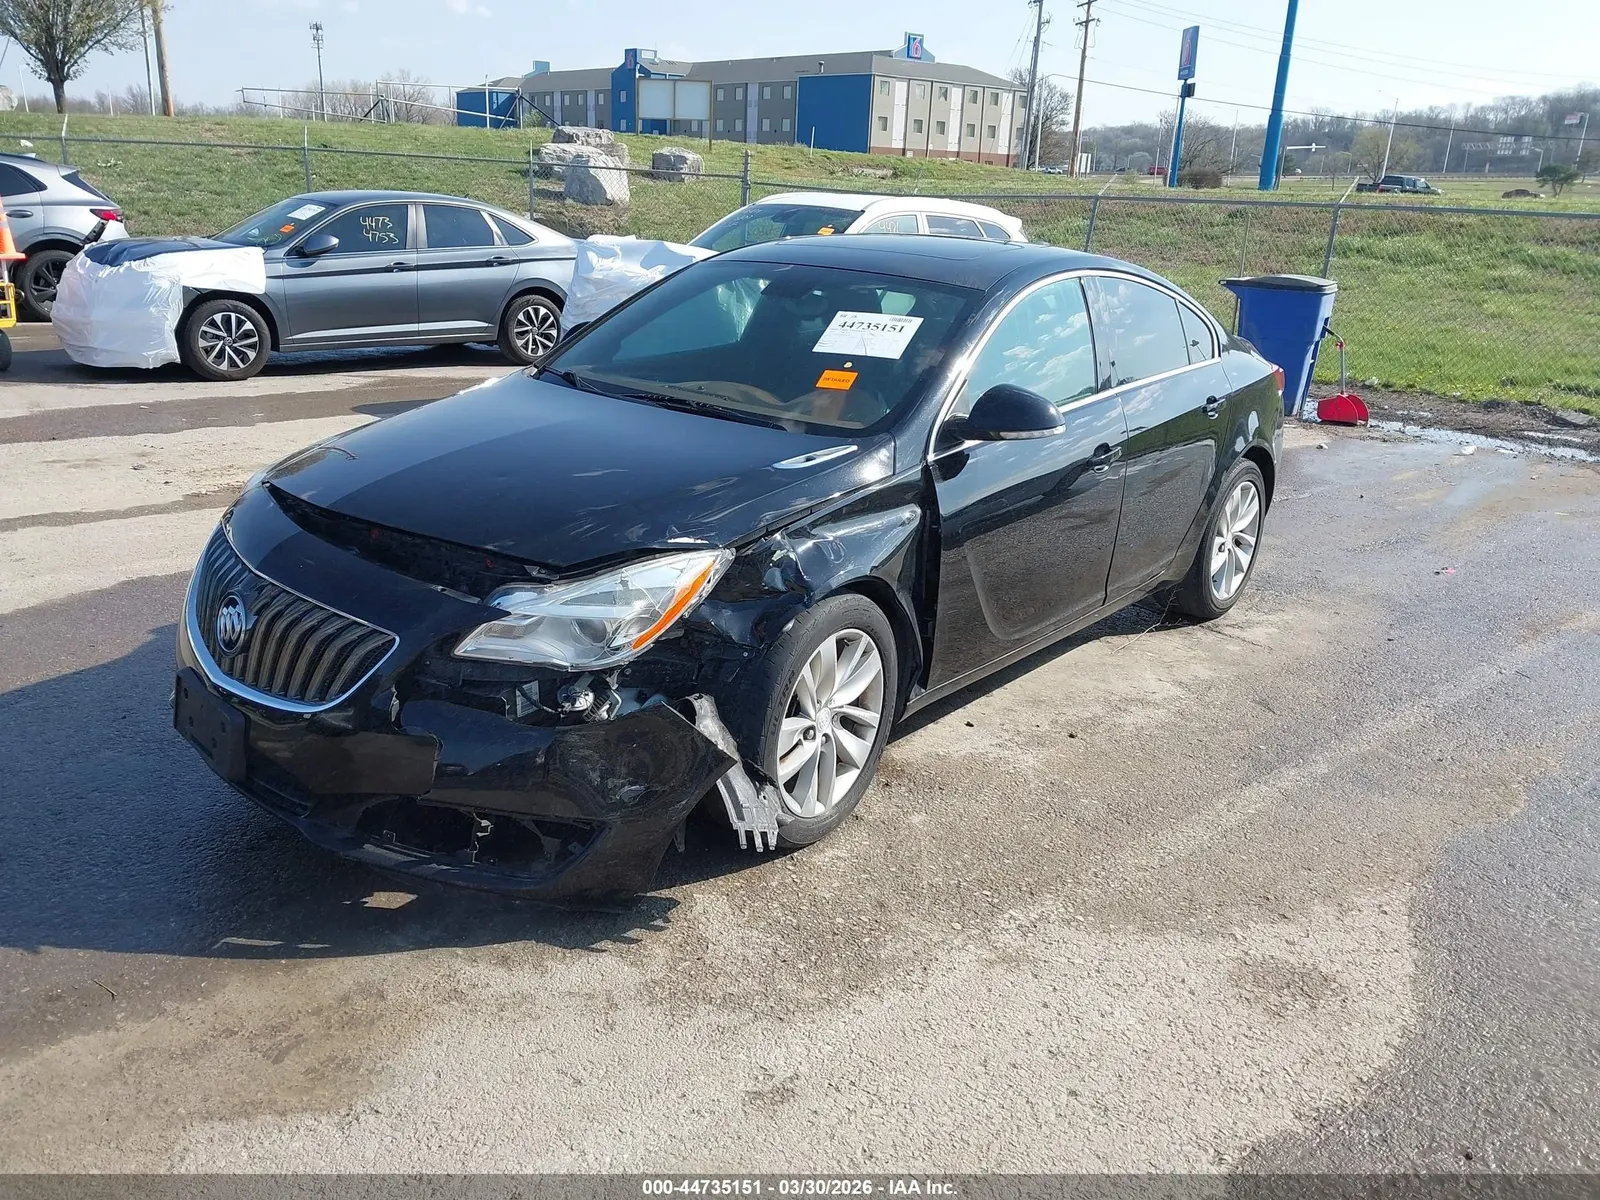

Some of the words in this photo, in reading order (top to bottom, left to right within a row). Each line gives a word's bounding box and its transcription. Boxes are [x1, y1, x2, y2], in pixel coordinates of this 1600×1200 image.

[912, 39, 922, 59] 6
[360, 216, 393, 230] 4473
[363, 229, 399, 244] 4753
[838, 320, 905, 333] 44735151
